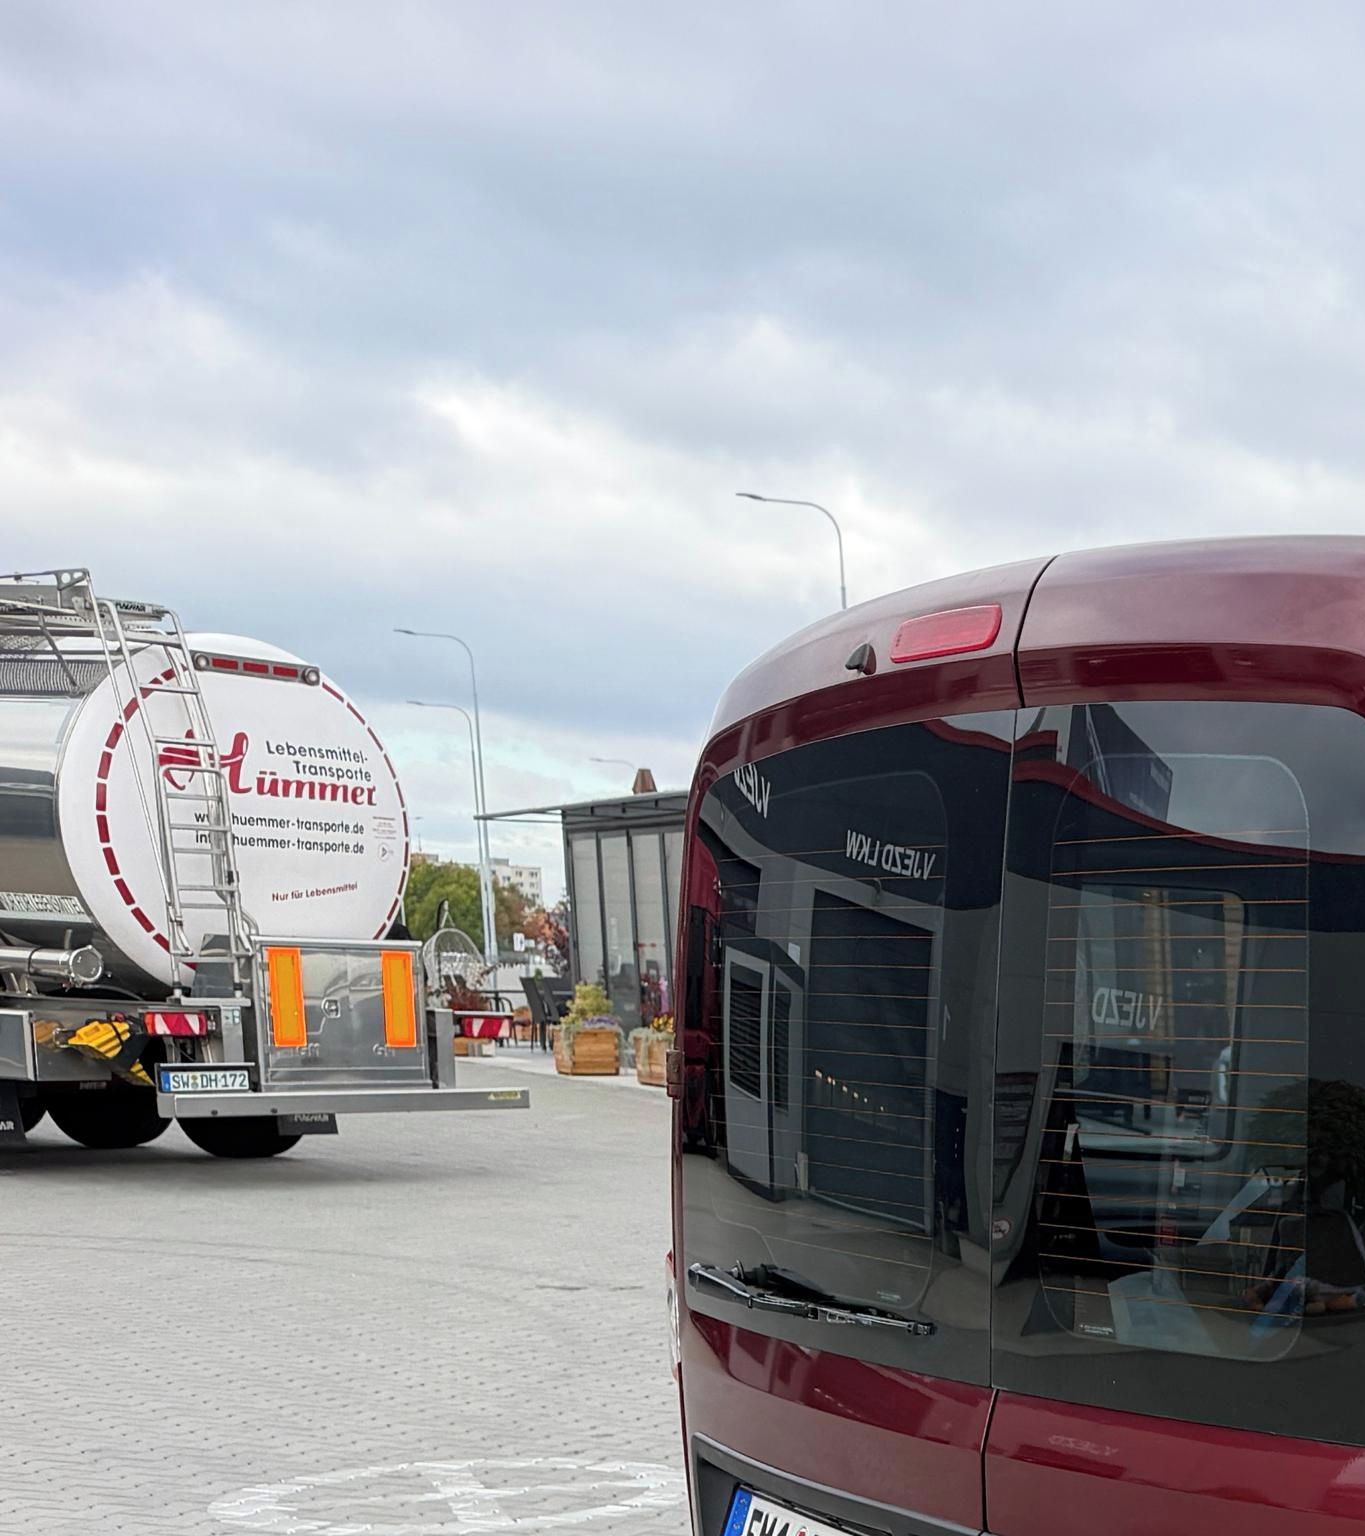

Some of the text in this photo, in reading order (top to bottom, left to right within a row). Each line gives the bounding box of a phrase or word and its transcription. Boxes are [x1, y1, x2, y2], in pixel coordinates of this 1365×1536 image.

[265, 740, 369, 764] Lebensmittel-
[292, 760, 372, 783] Transporte
[271, 880, 358, 902] Nur für Lebensmittel
[172, 1073, 247, 1089] SW DH 172
